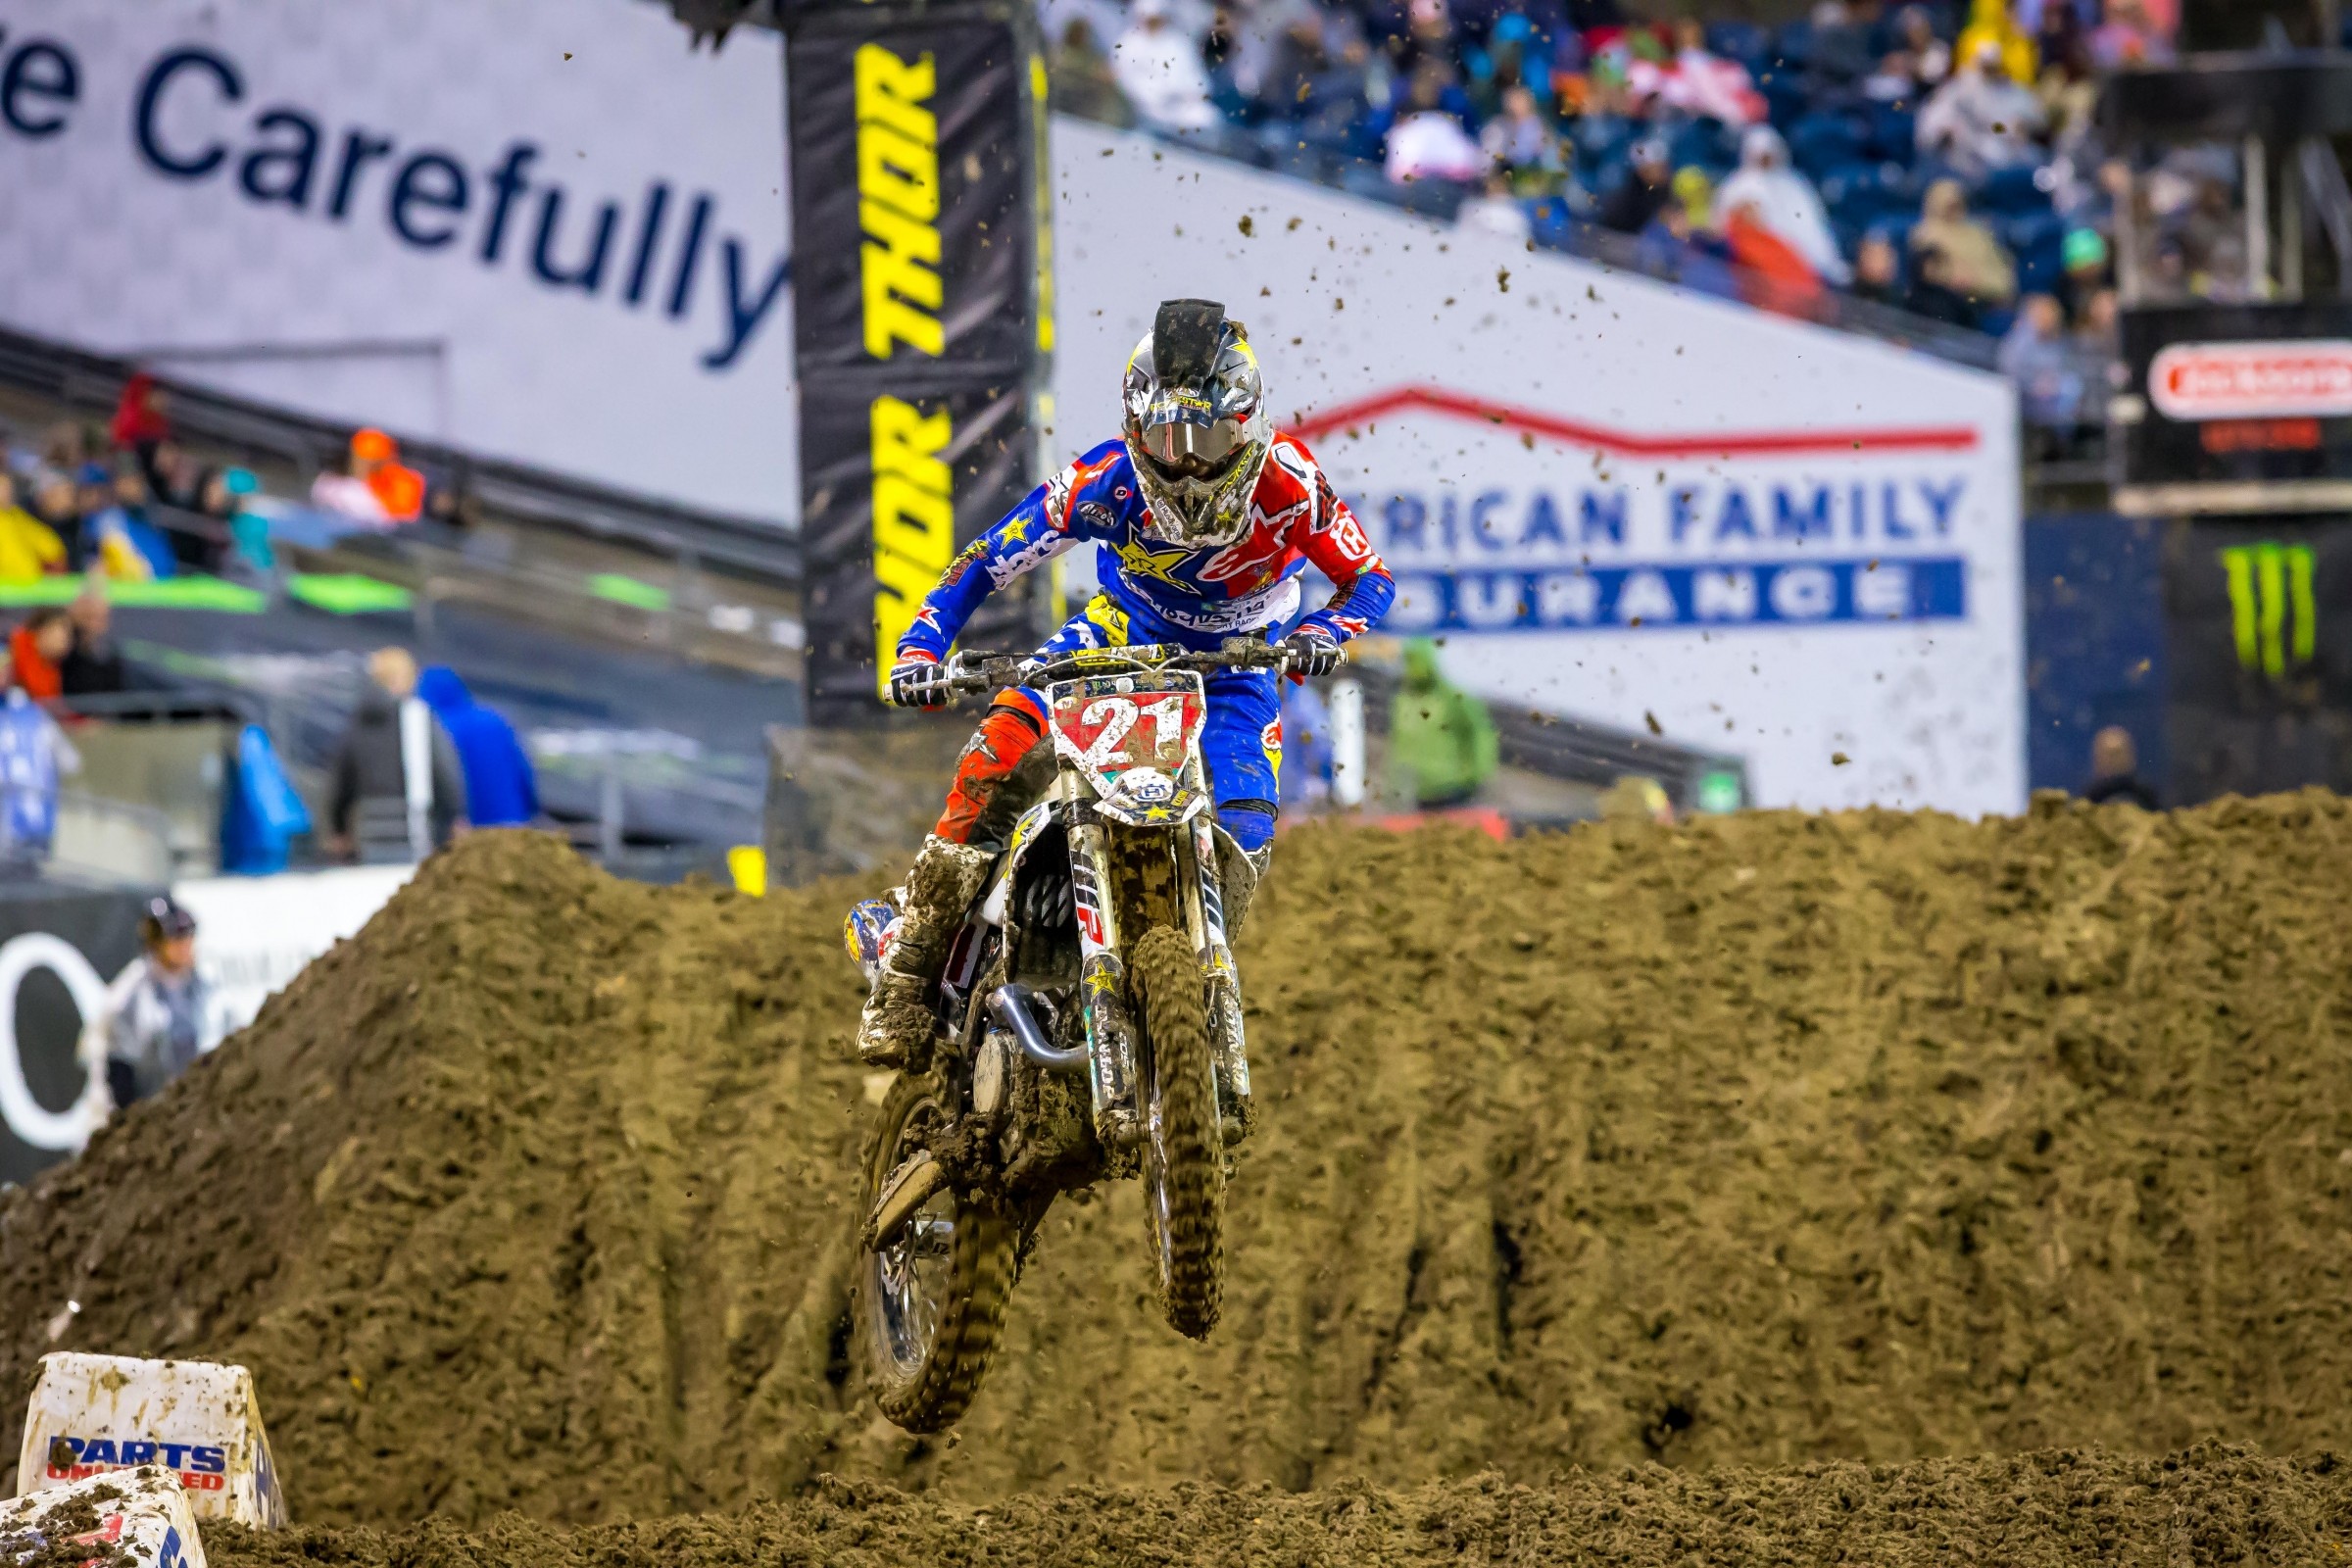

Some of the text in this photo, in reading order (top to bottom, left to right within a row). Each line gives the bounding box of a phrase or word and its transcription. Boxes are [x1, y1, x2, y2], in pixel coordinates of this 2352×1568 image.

[131, 44, 788, 369] Carefully
[854, 41, 946, 361] THOR
[1345, 478, 1959, 551] RICAN FAMILY
[1392, 567, 1911, 628] SURANCE
[1081, 696, 1184, 766] 21
[48, 1436, 225, 1472] PARTS
